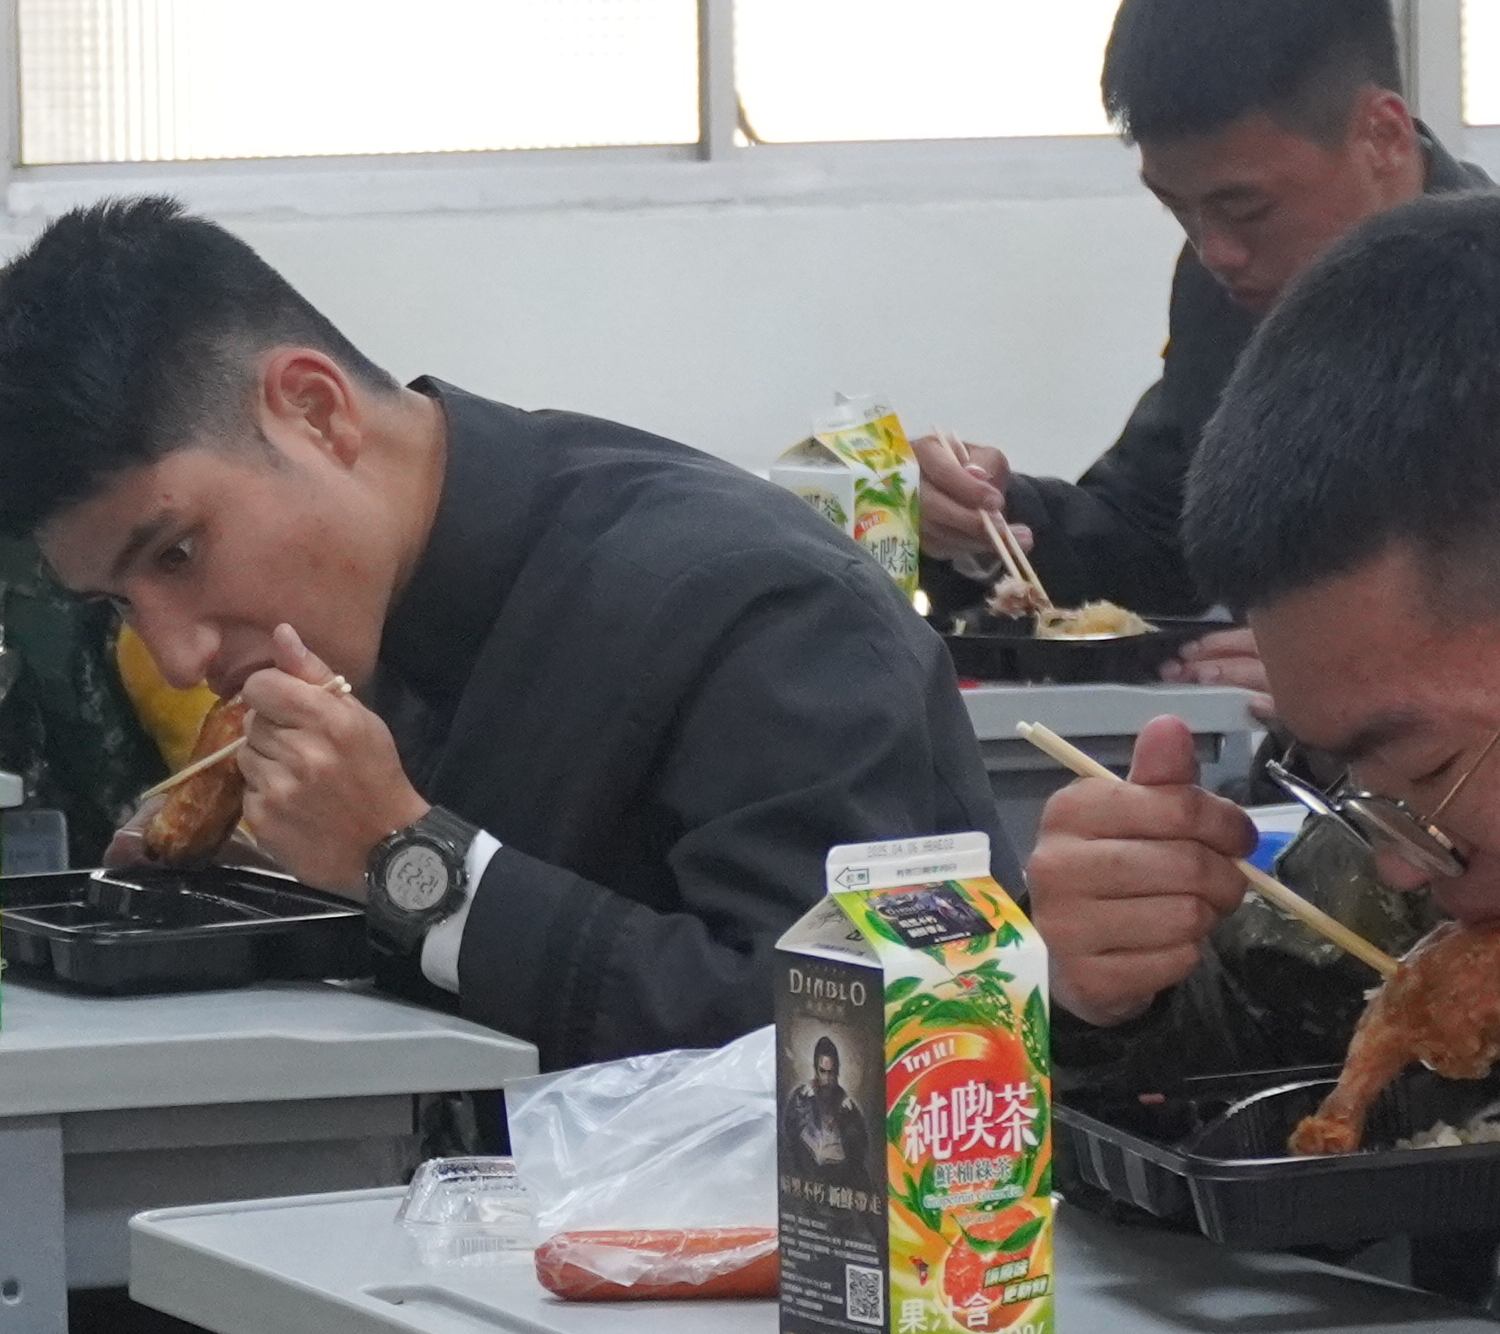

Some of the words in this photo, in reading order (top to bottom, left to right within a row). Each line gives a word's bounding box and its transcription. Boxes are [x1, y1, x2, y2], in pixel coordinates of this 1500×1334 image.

[789, 968, 867, 1007] DIABLO
[901, 1050, 931, 1073] Try
[904, 1079, 1040, 1164] 純喫茶
[935, 1156, 1012, 1186] 鮮柚綠茶
[898, 1292, 993, 1334] 果汁含
